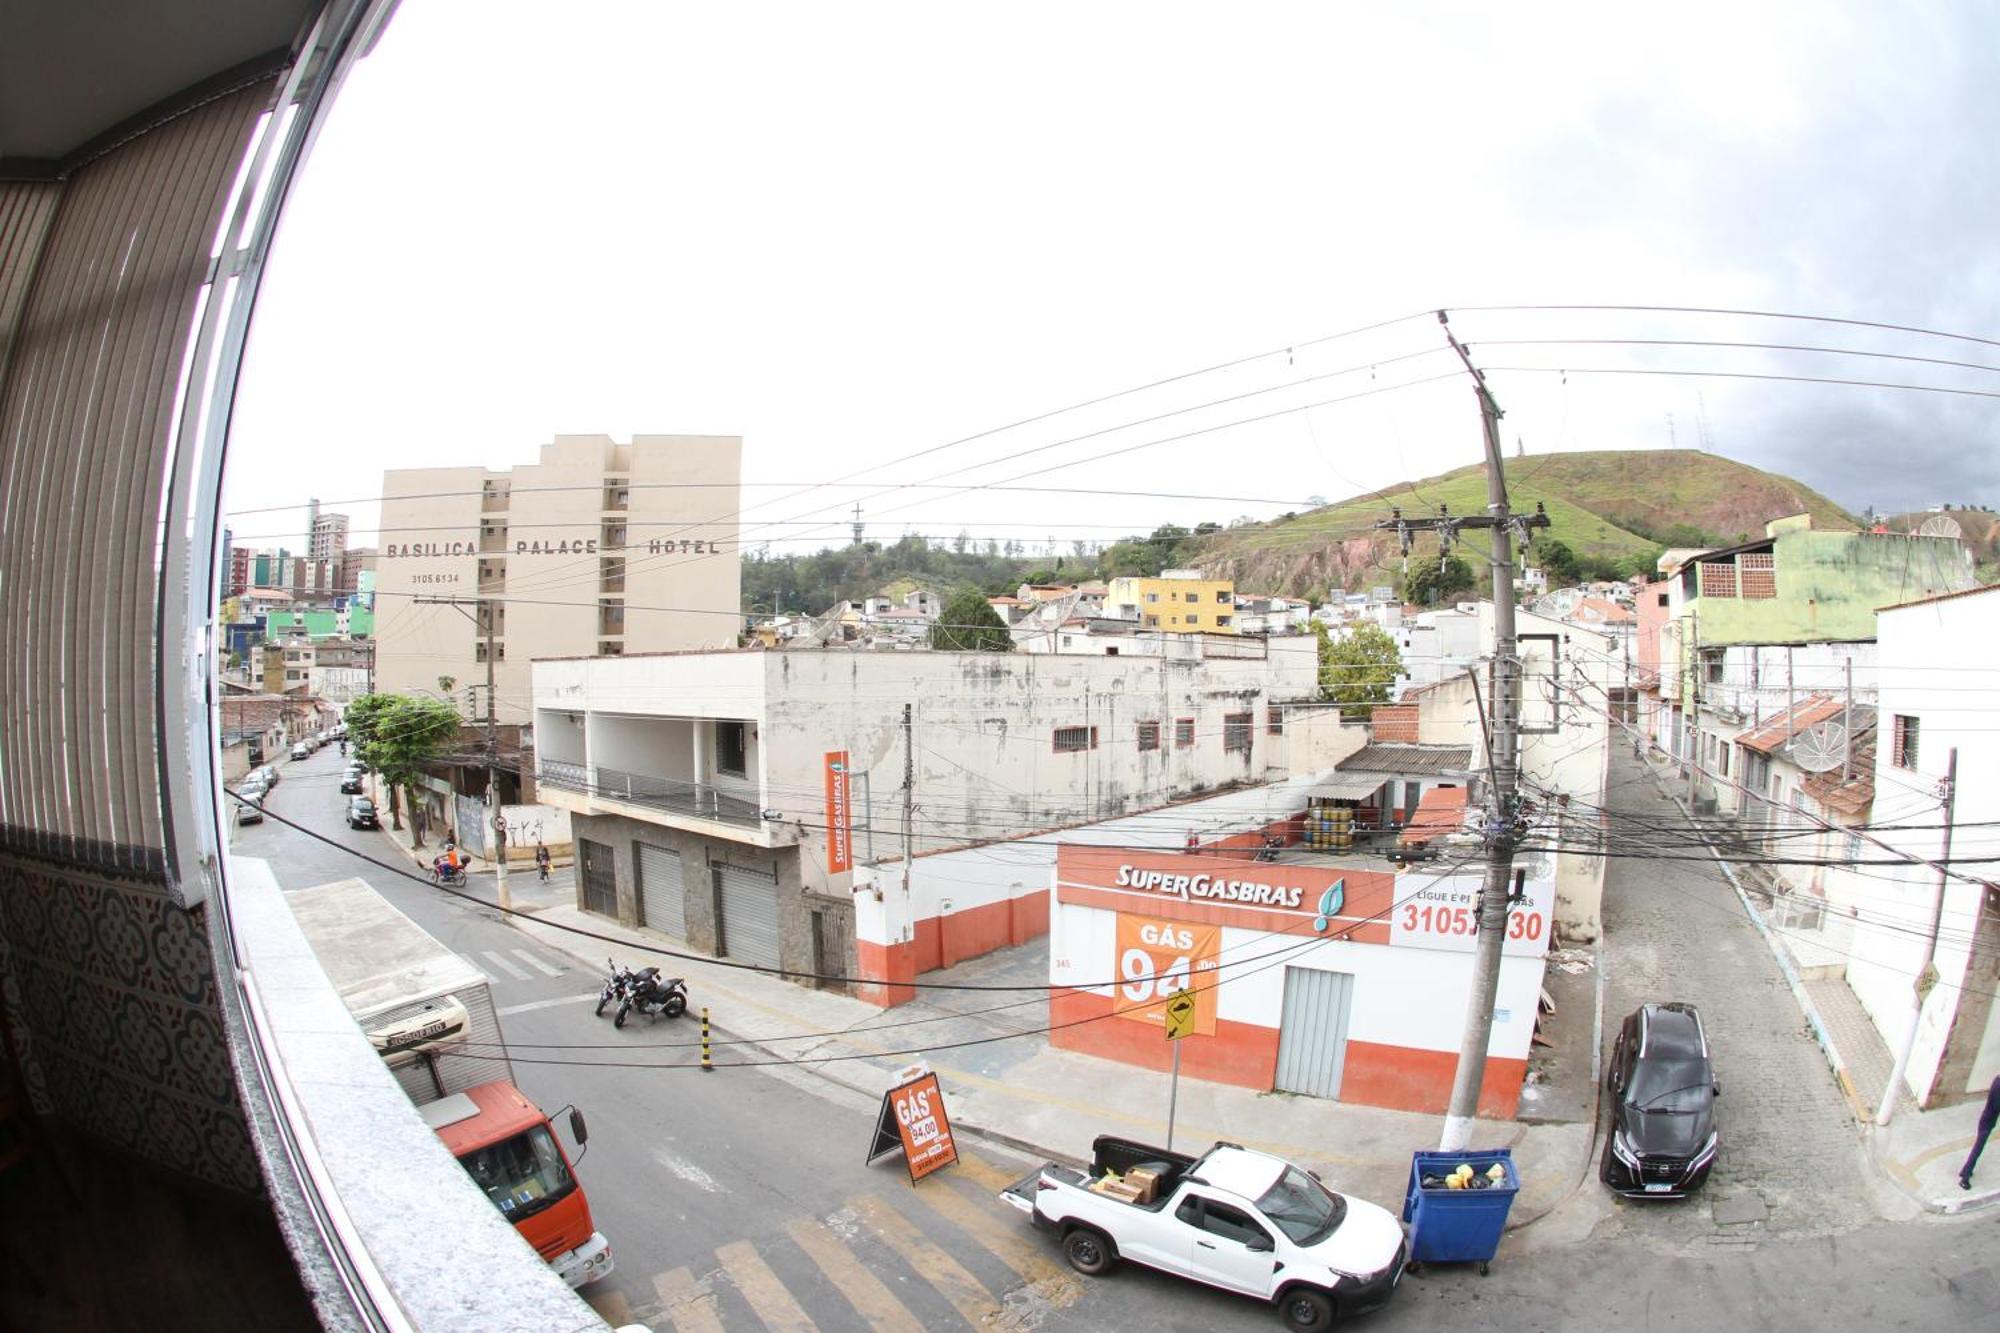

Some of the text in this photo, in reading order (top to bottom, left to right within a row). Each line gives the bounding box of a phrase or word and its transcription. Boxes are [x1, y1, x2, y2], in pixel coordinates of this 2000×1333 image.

[387, 540, 720, 558] BASILICA PALACE HOTEL
[1416, 891, 1448, 901] LIGUE
[1450, 894, 1458, 902] E
[1141, 923, 1193, 950] GÁS
[1120, 948, 1190, 1002] 94
[896, 1088, 930, 1126] GÁS
